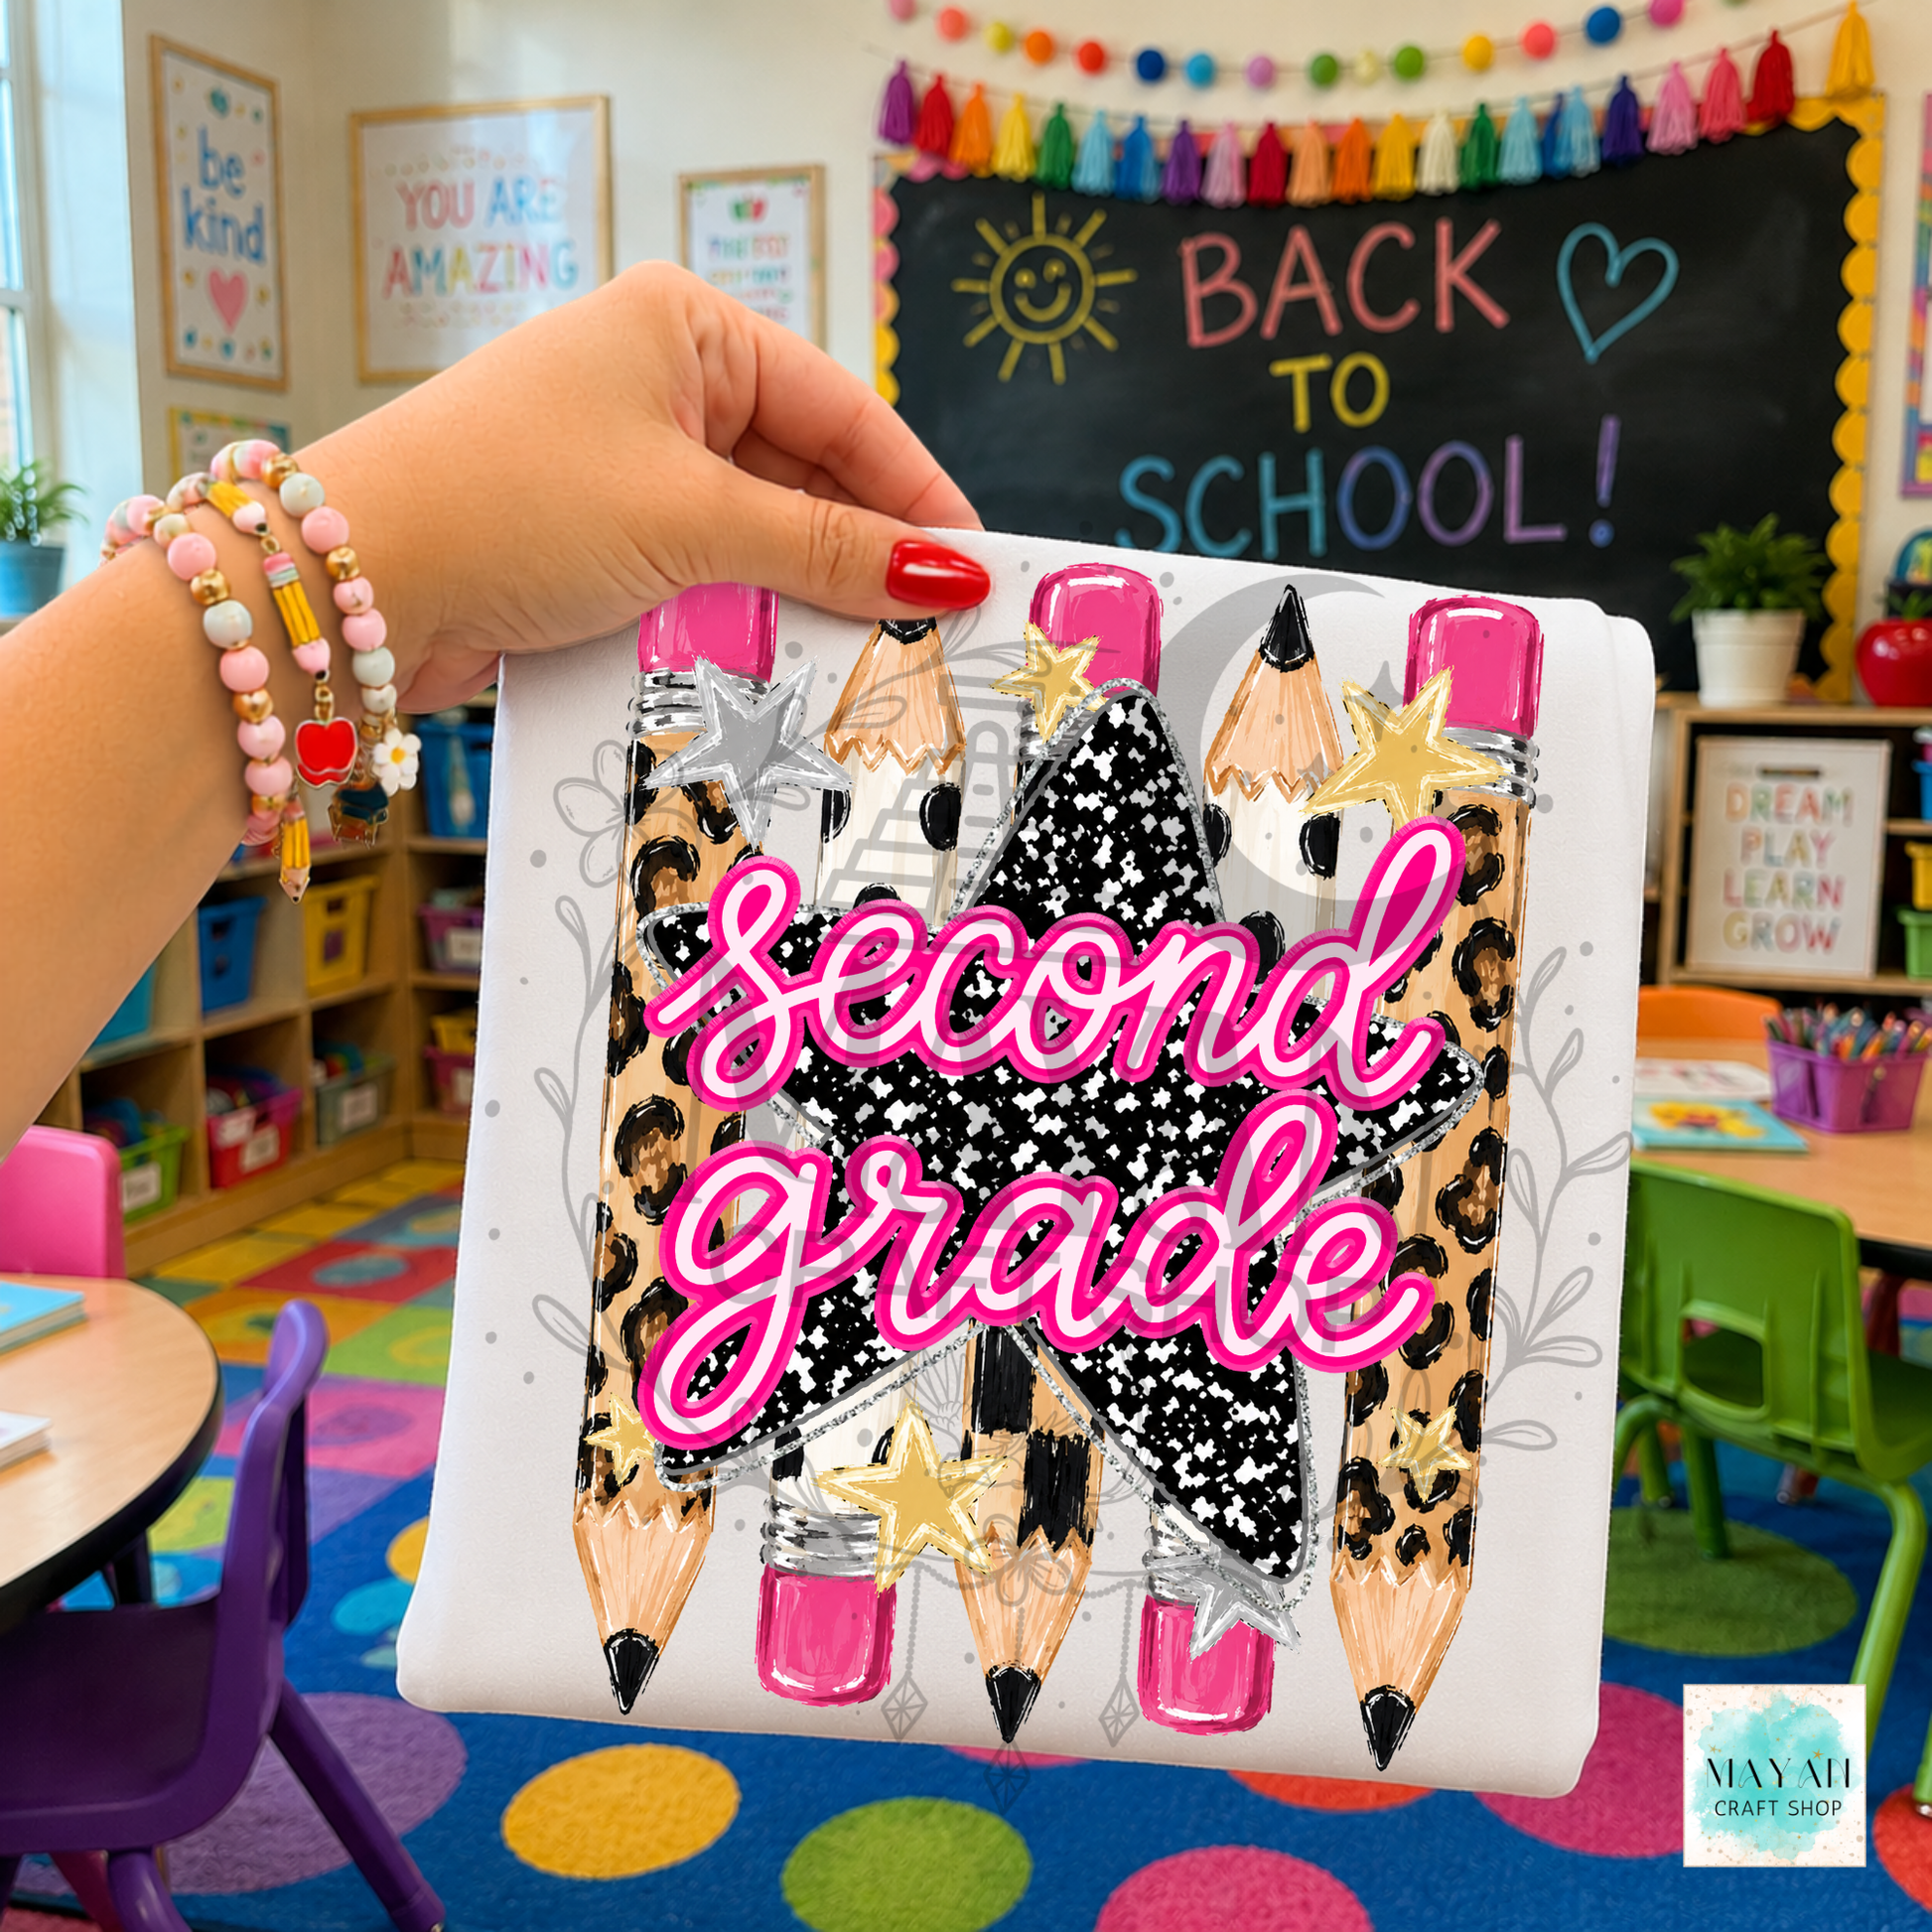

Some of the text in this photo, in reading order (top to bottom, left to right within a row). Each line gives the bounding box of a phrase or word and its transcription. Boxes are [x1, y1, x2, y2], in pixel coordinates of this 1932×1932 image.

[198, 125, 245, 198] be
[182, 186, 266, 266] kind
[396, 176, 562, 230] YOU ARE
[382, 238, 579, 299] AMAZING
[1178, 216, 1510, 347] BACK
[1270, 351, 1390, 434] TO
[1725, 782, 1856, 827] DREAM
[1740, 826, 1836, 869] PLAY
[1723, 867, 1846, 911] LEARN
[643, 816, 1466, 1110] second
[1723, 910, 1843, 954] GROW
[637, 1089, 1436, 1450] grade
